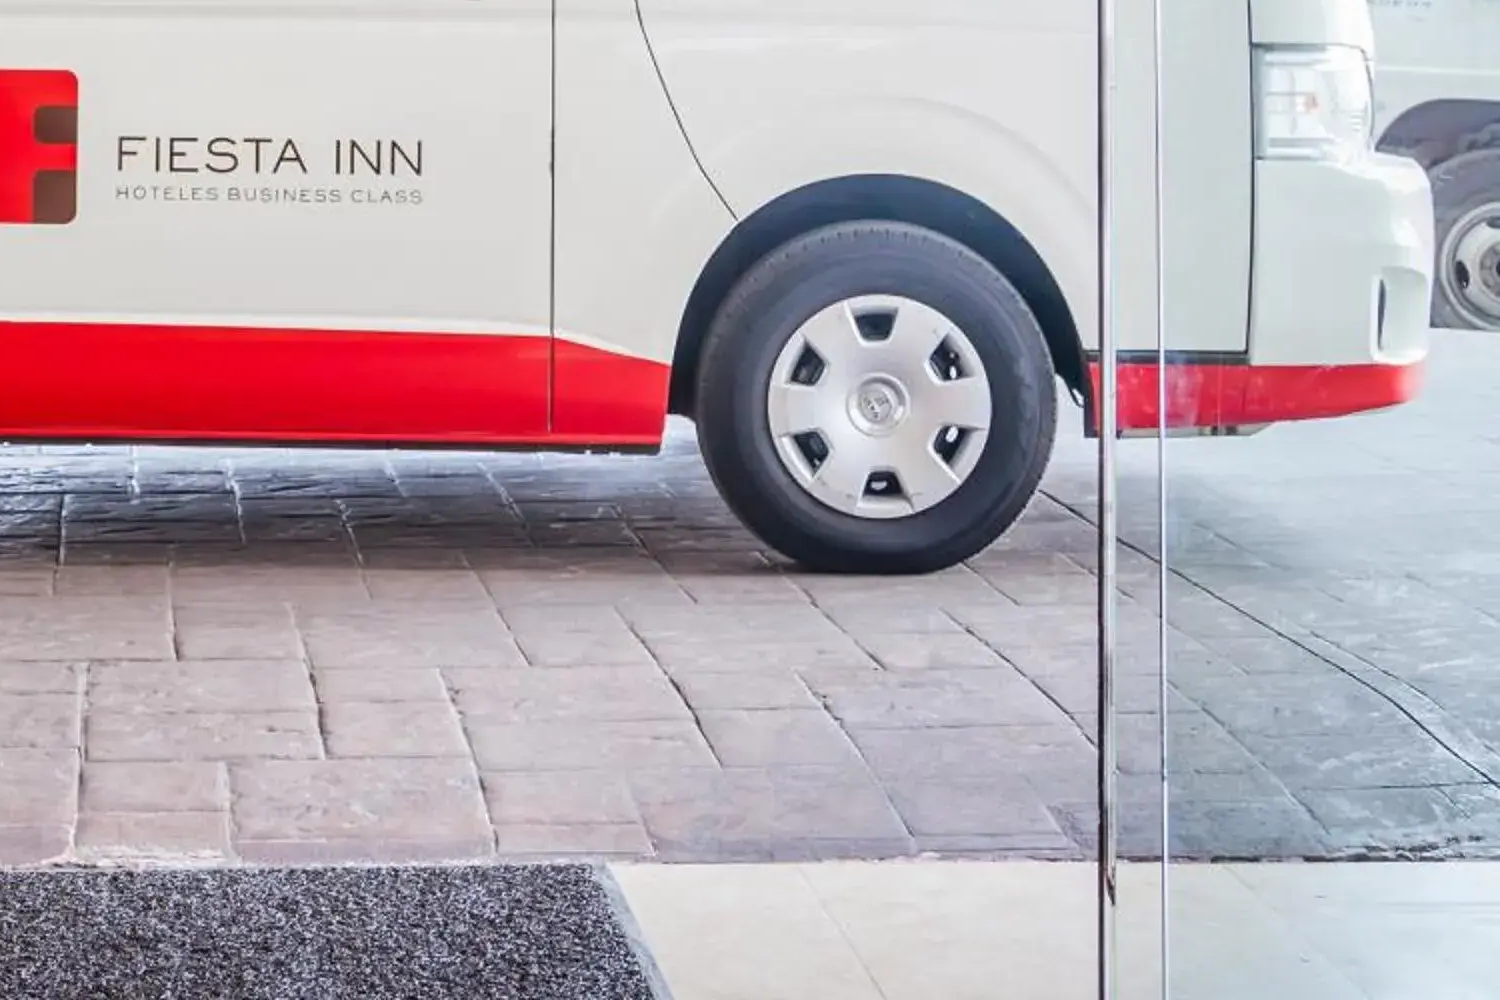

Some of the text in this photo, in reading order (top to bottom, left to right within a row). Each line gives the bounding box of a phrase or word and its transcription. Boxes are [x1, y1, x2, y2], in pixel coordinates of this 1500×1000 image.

[116, 135, 424, 177] FIESTA INN
[114, 185, 424, 205] HOTELES BUSINESS CLASS
